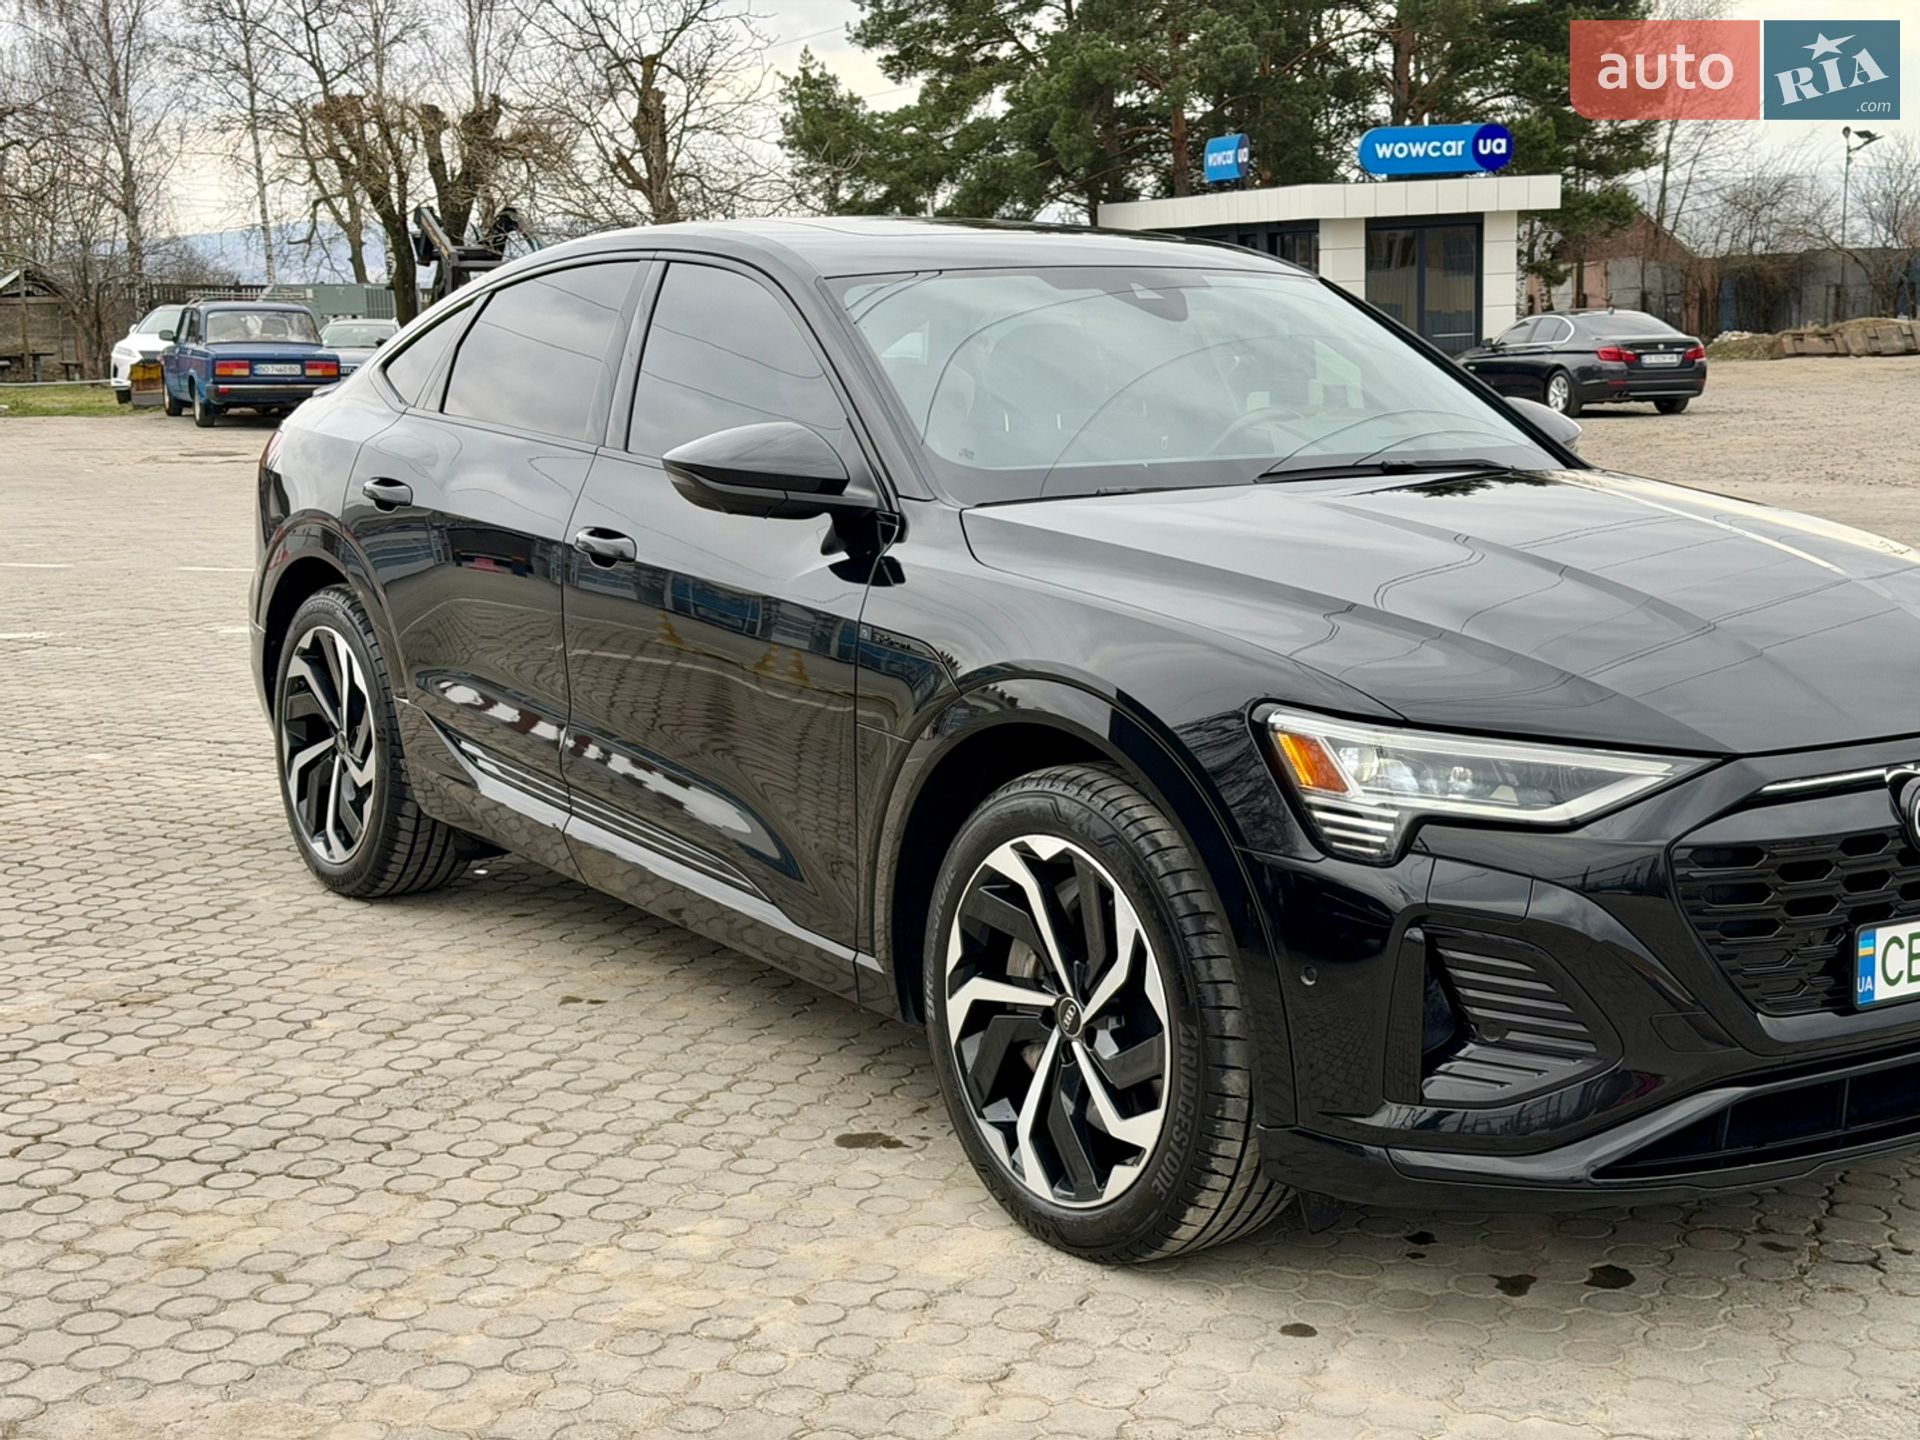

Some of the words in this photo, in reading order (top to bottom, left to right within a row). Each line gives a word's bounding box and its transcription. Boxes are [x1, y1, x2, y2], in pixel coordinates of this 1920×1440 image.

[1375, 139, 1466, 159] wowcar
[1477, 137, 1507, 155] ua
[1857, 975, 1874, 993] UA
[1151, 1021, 1200, 1200] BRIDGESTONE
